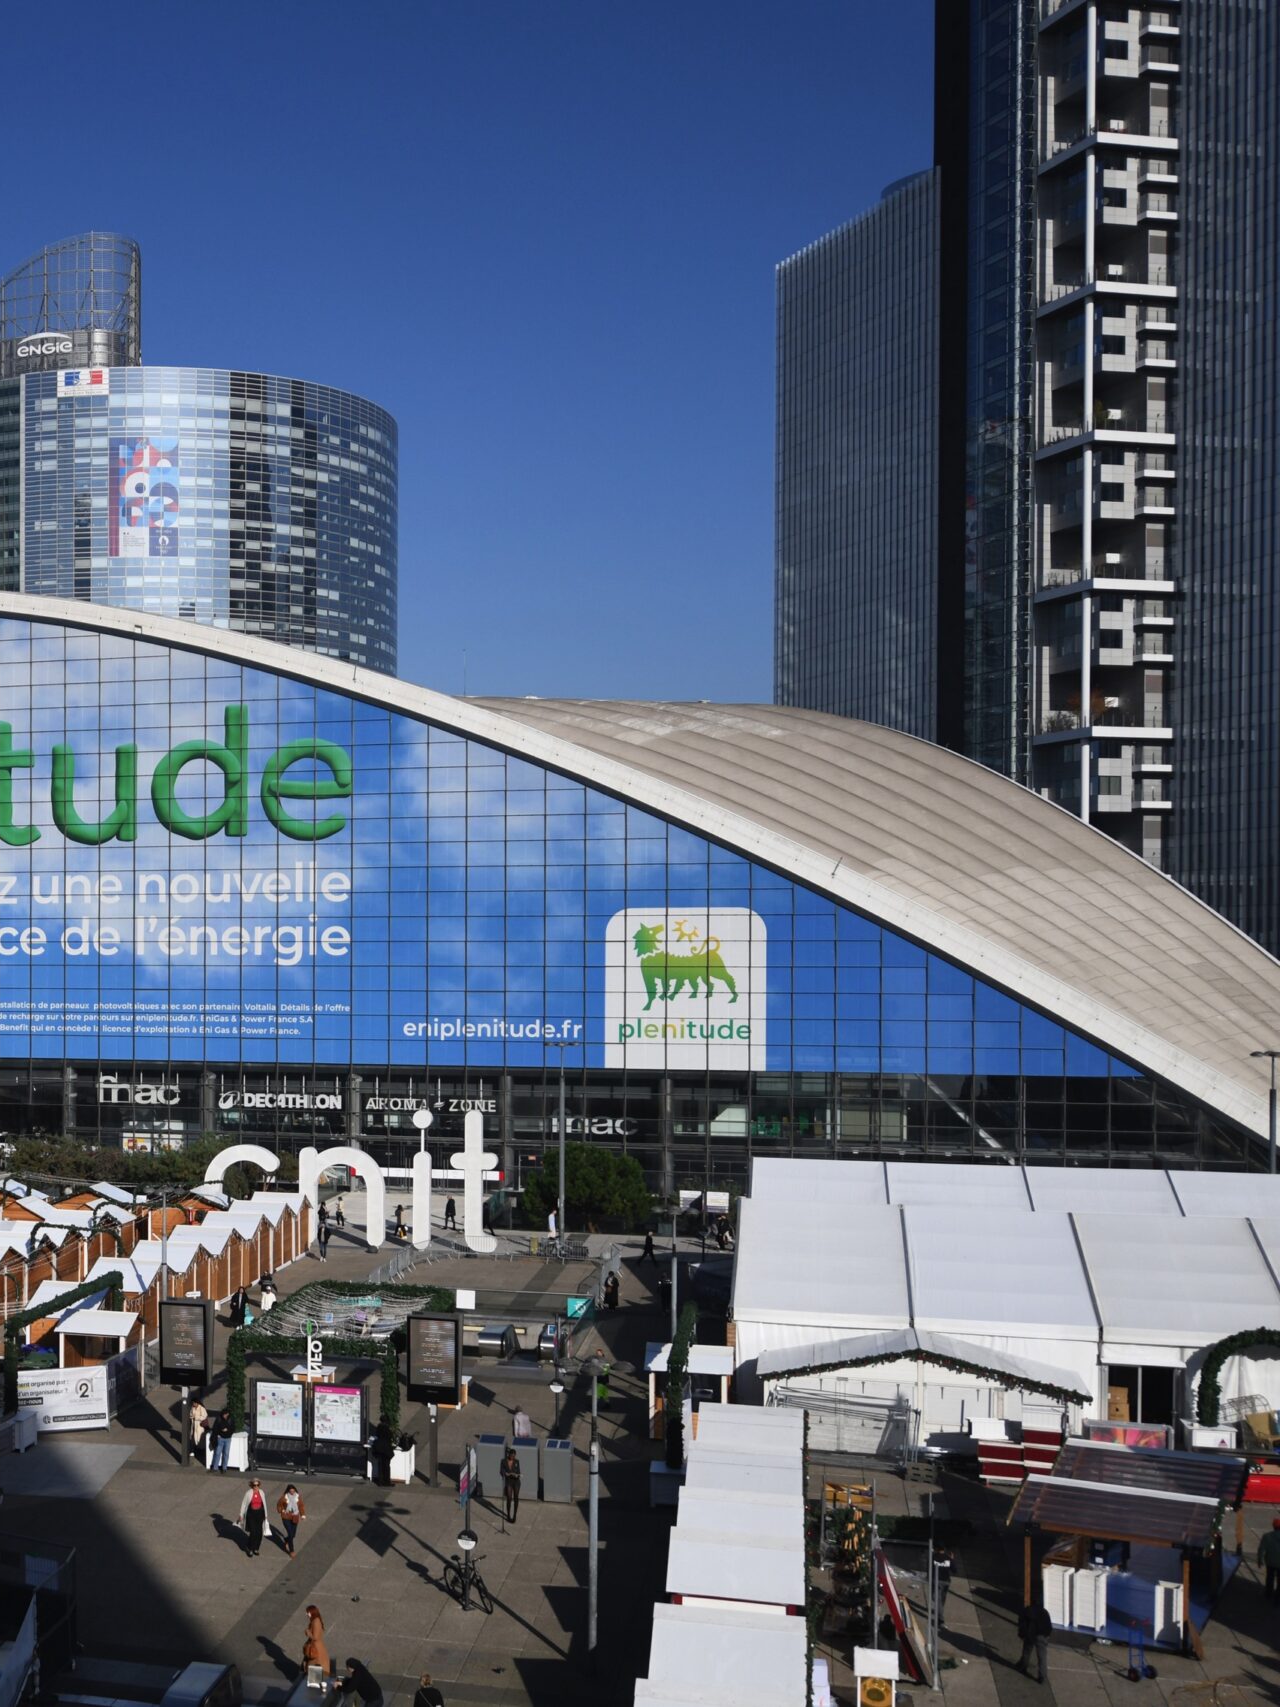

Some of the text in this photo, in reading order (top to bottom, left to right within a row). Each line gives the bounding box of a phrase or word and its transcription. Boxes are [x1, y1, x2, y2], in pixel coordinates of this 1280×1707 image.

[32, 874, 123, 905] une
[139, 861, 352, 904] nouvelle
[60, 917, 120, 958] de
[135, 914, 352, 967] l'énergie
[403, 1018, 583, 1041] eniplenitude.fr
[618, 1018, 752, 1044] plenitude
[96, 1075, 181, 1105] fnac
[243, 1092, 342, 1110] DECATHLON
[365, 1097, 497, 1113] AROMA ZONE
